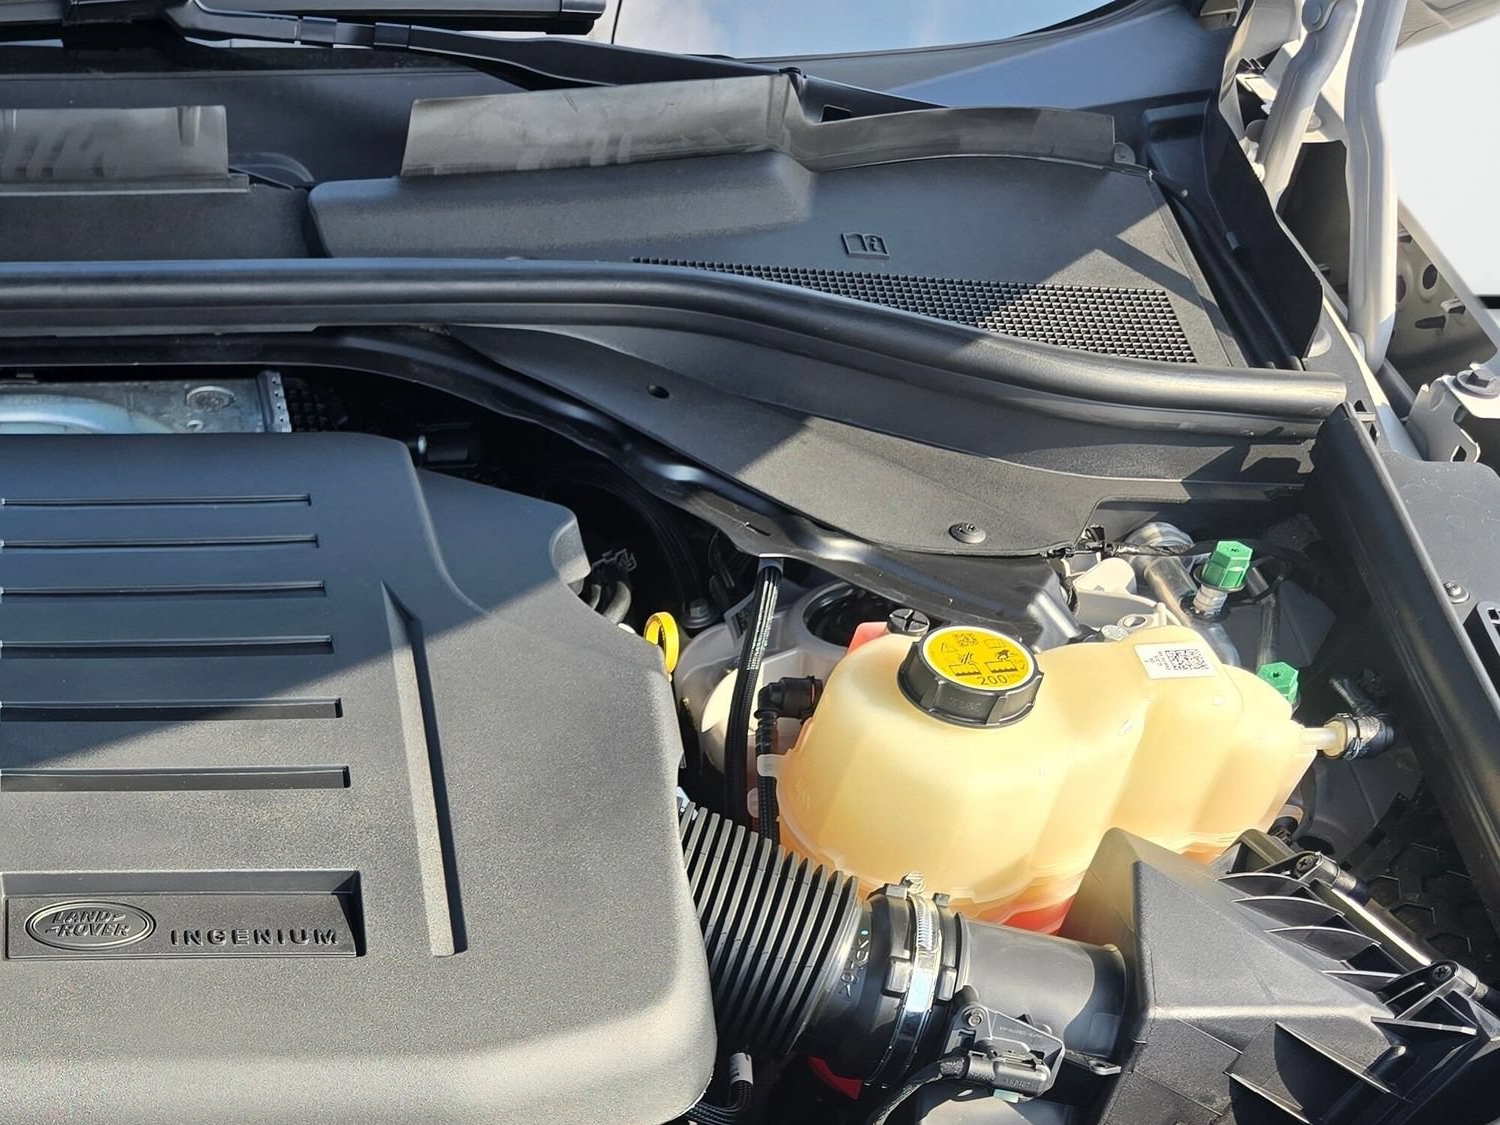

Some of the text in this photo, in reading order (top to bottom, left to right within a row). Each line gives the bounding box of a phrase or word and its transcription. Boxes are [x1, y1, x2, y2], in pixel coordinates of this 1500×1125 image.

[977, 675, 1008, 685] 200
[51, 911, 108, 923] LAND
[56, 922, 131, 937] ROVER
[169, 927, 339, 946] INGENIUM
